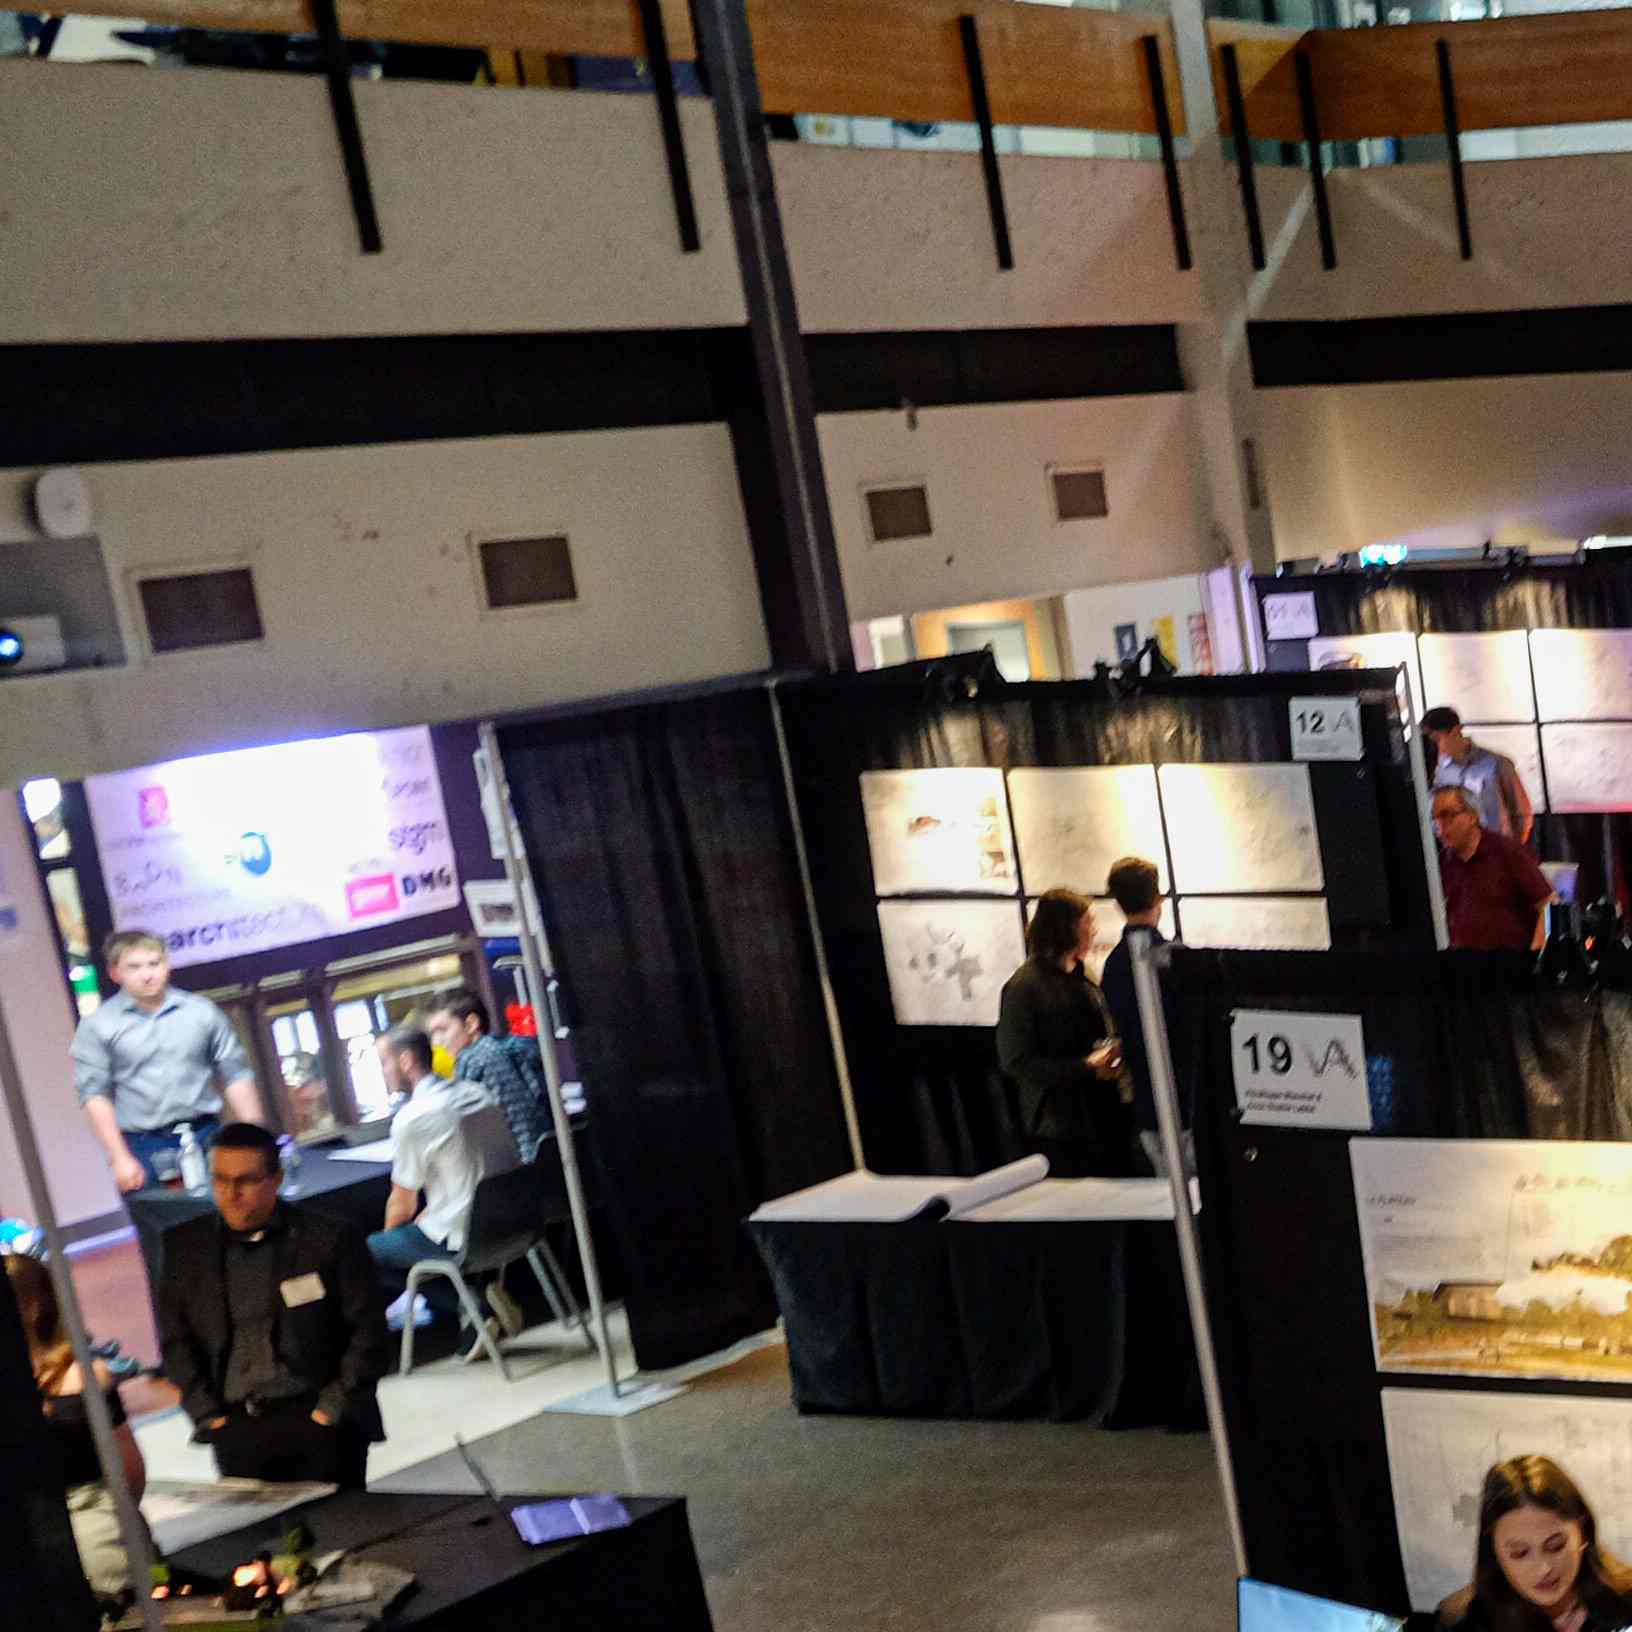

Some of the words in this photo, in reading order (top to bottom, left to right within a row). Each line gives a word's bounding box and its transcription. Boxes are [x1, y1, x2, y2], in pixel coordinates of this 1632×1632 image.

[1296, 710, 1326, 736] 12
[402, 866, 451, 898] DMG
[1242, 1032, 1293, 1076] 19
